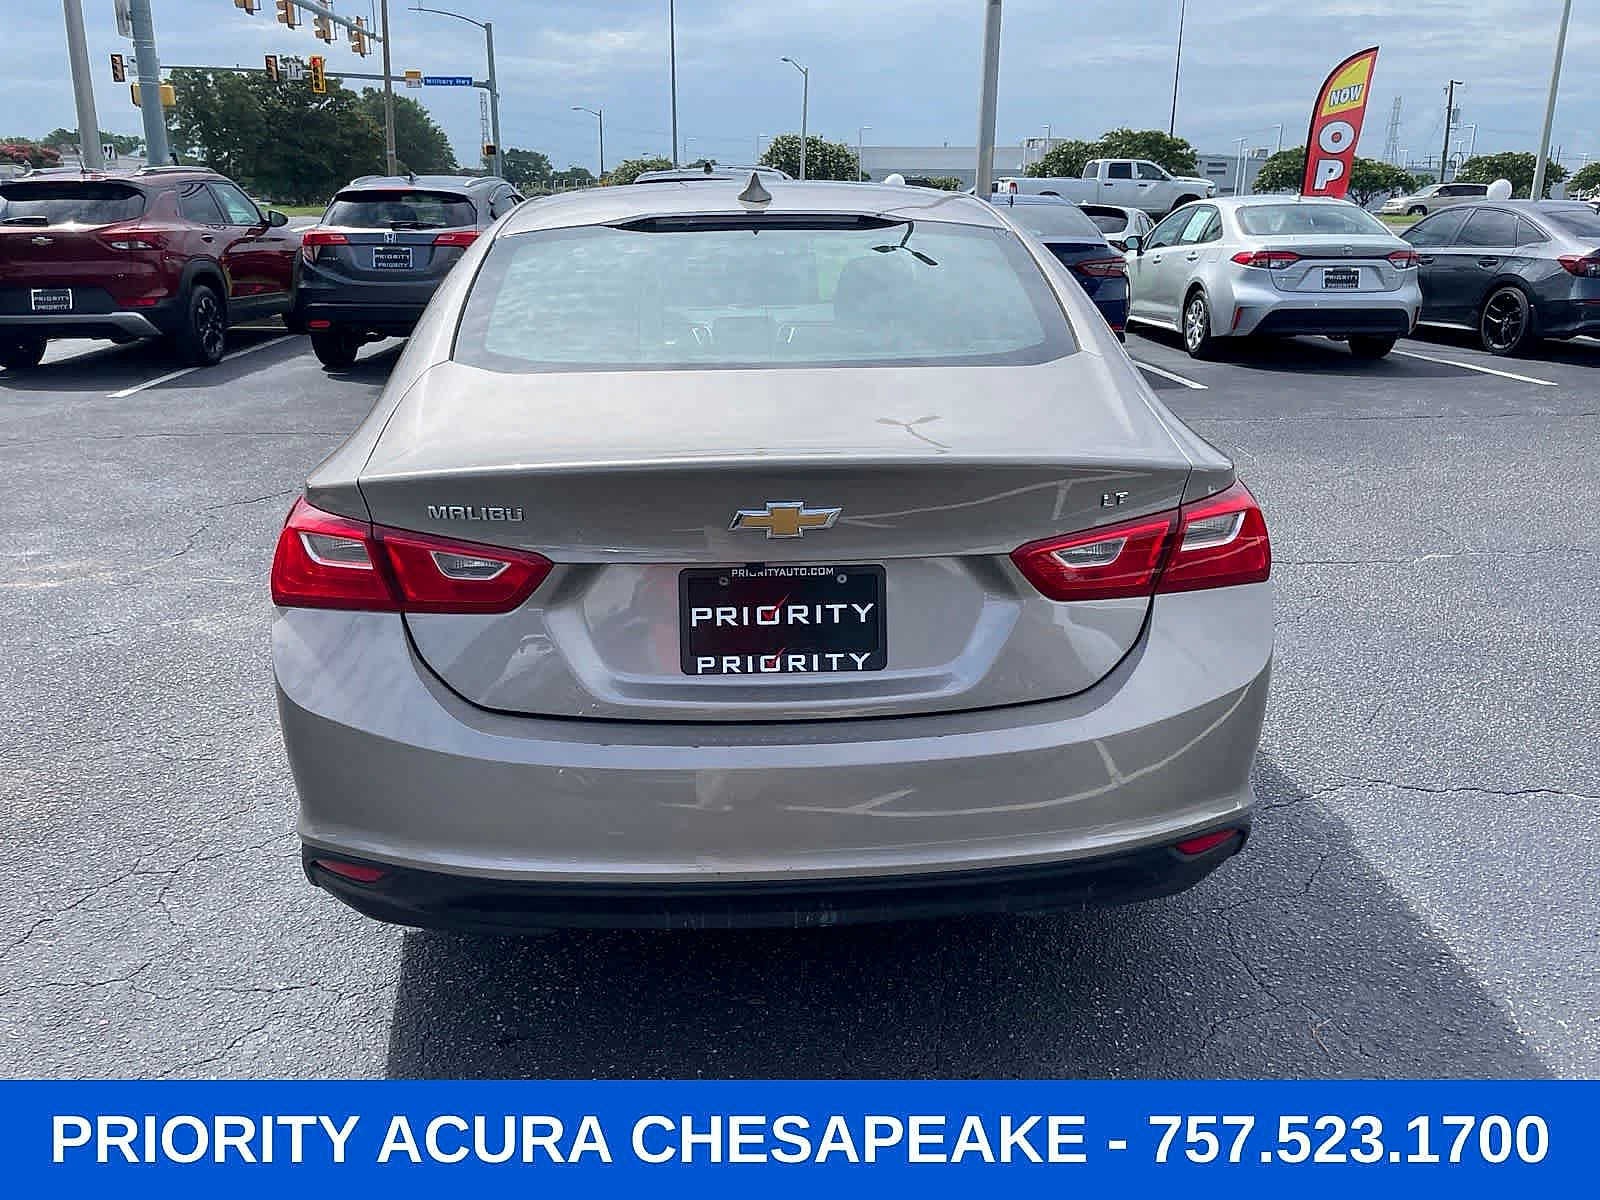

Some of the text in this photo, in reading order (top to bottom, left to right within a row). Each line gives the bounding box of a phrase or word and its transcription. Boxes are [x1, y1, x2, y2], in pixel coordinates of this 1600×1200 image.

[1330, 84, 1363, 106] NOW
[427, 505, 523, 521] MALIBU
[731, 567, 834, 577] PRIORITYAUTO.COM
[691, 603, 874, 627] PRIORITY
[697, 652, 871, 673] PRIORITY
